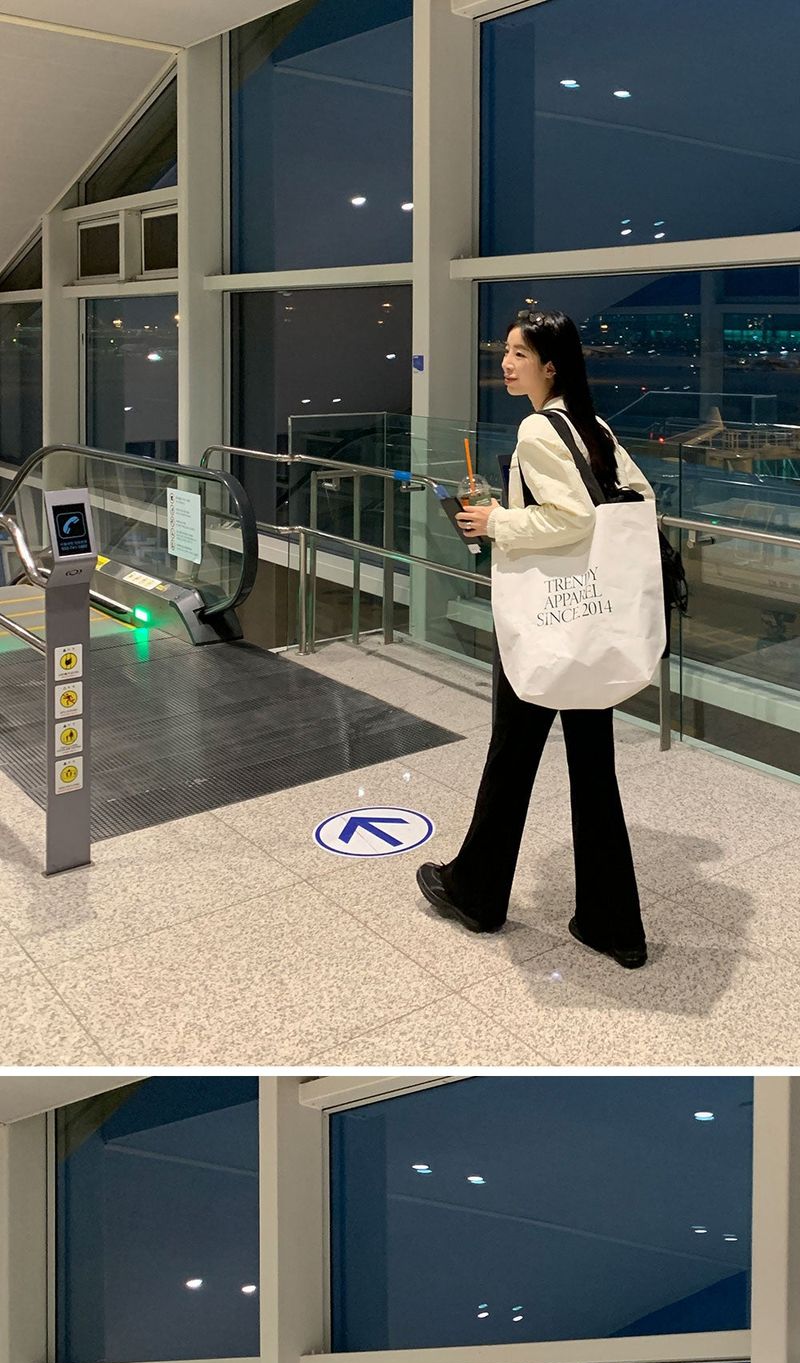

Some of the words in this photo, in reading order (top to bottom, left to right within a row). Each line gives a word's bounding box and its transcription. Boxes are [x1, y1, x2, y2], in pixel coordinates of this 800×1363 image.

[544, 567, 598, 593] TRENDY
[544, 584, 602, 609] APPAREL
[582, 600, 613, 617] 2014
